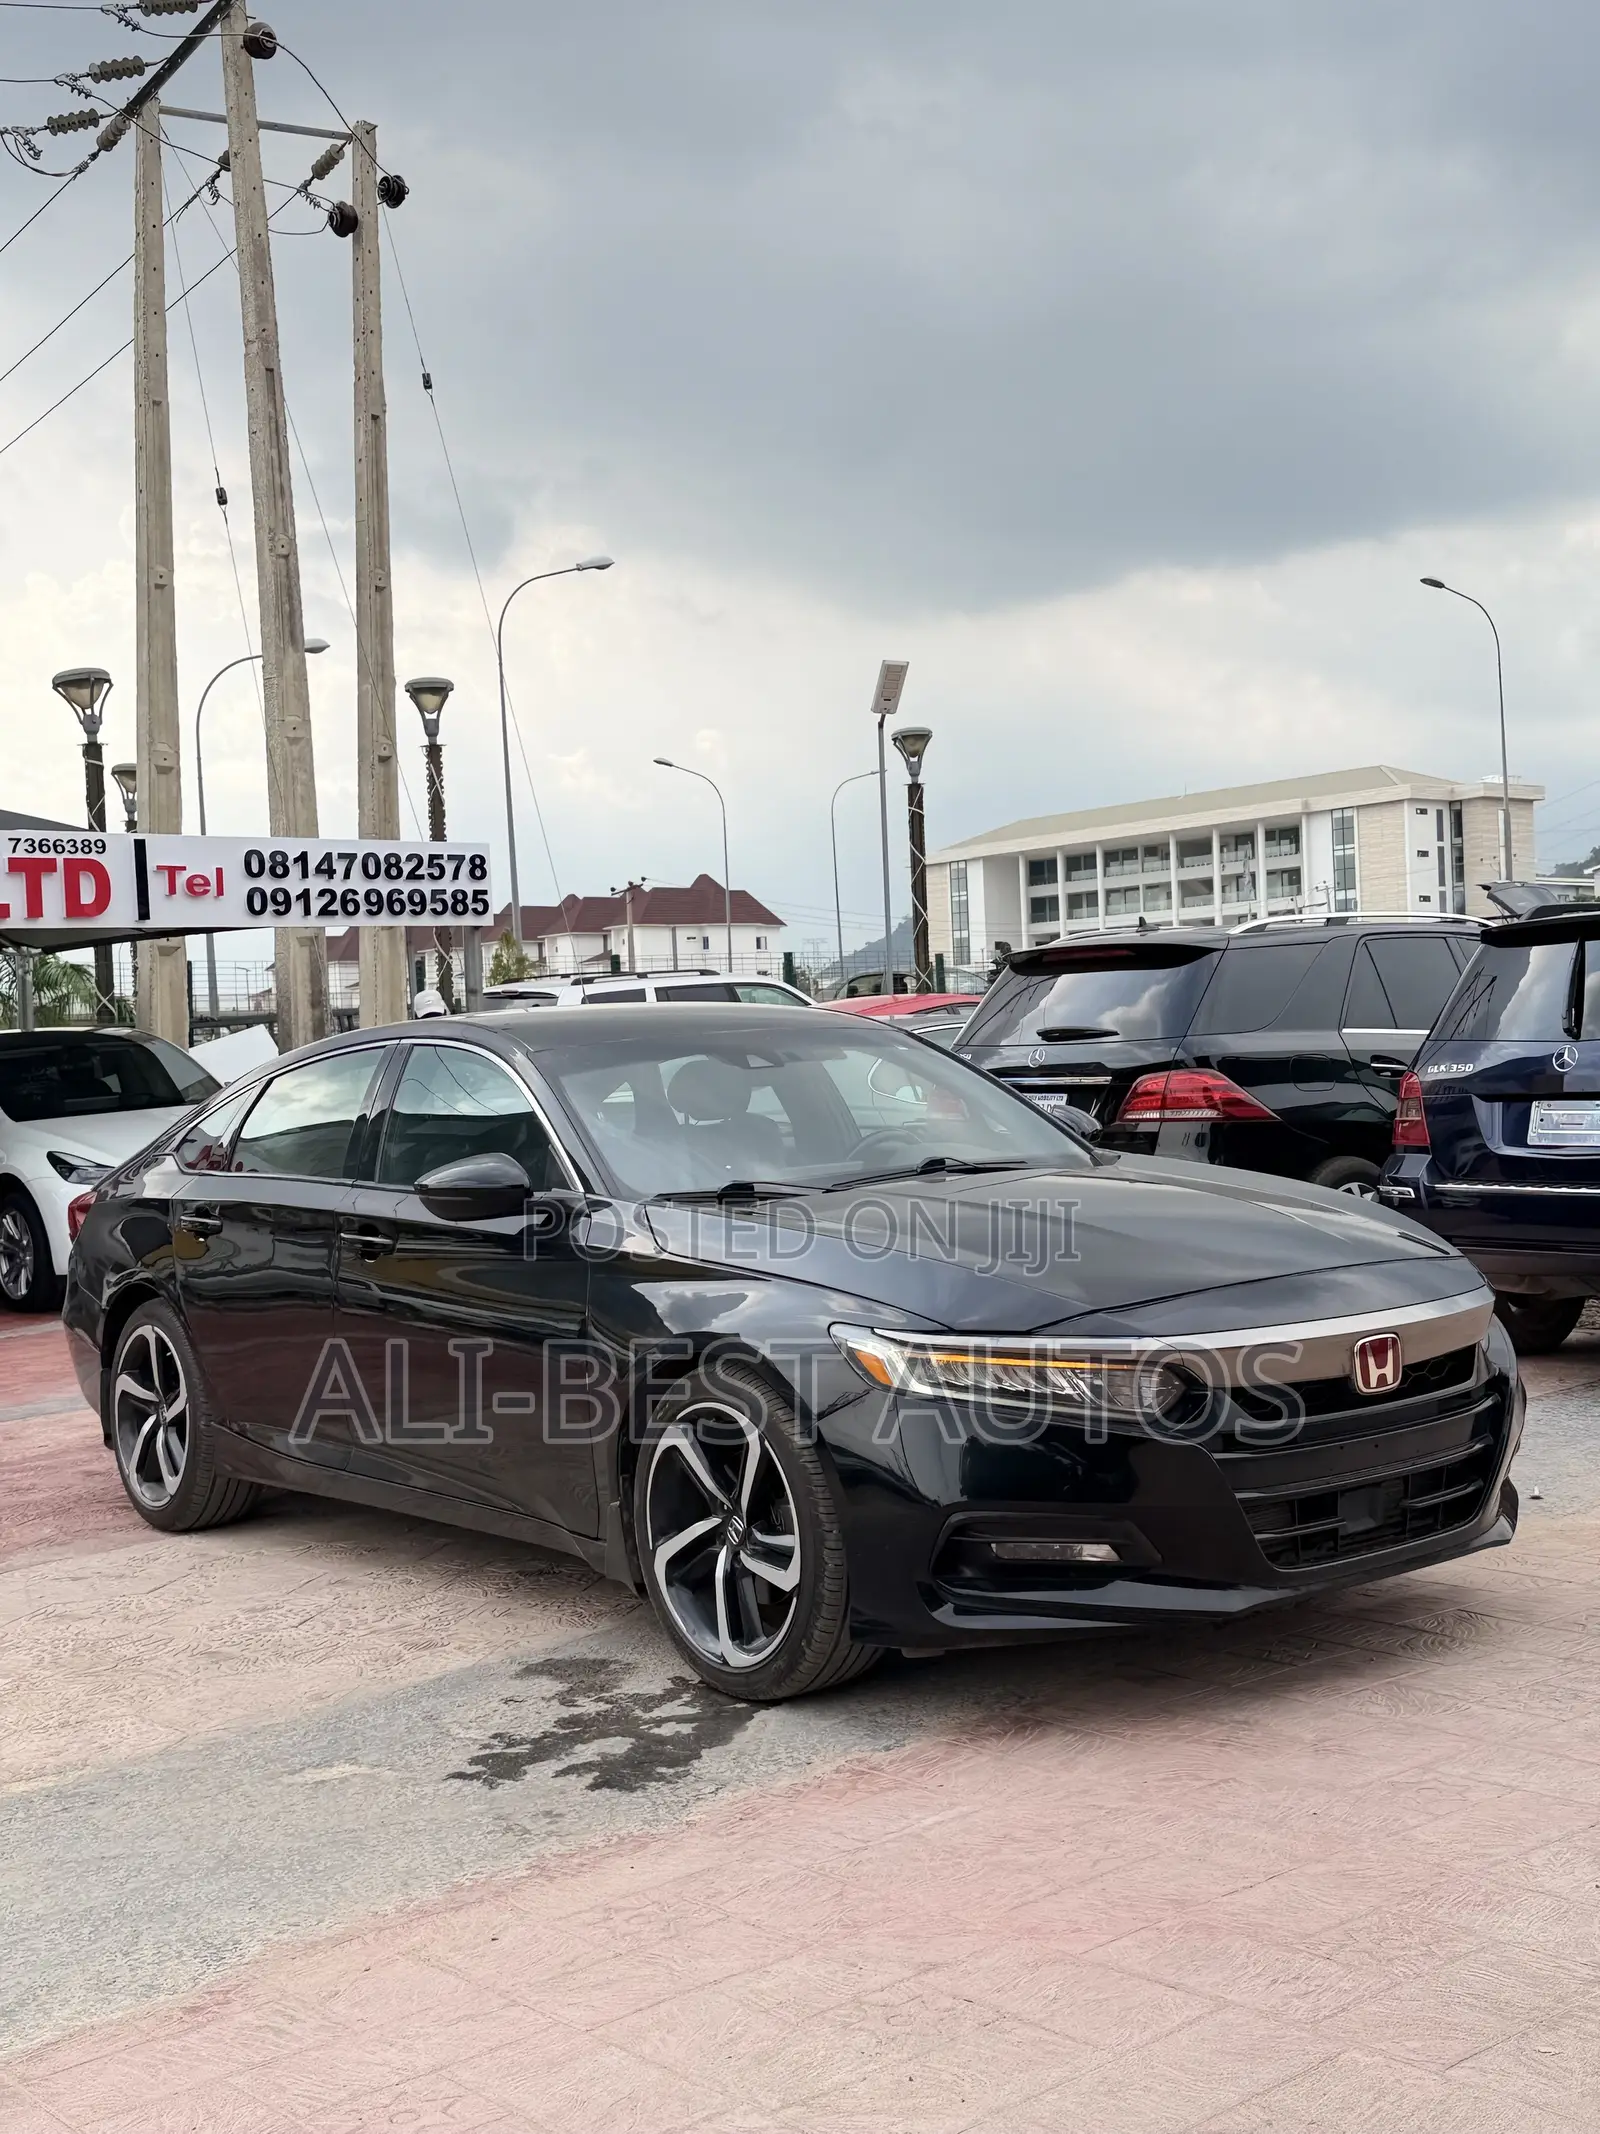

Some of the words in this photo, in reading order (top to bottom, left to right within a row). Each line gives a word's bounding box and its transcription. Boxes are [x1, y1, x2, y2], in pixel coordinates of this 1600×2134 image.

[8, 837, 107, 855] 7366389
[243, 849, 488, 881] 08147082578
[155, 865, 225, 897] Tel
[246, 886, 491, 917] 09126969585
[1427, 1064, 1447, 1074] GLK
[1449, 1063, 1474, 1072] 350
